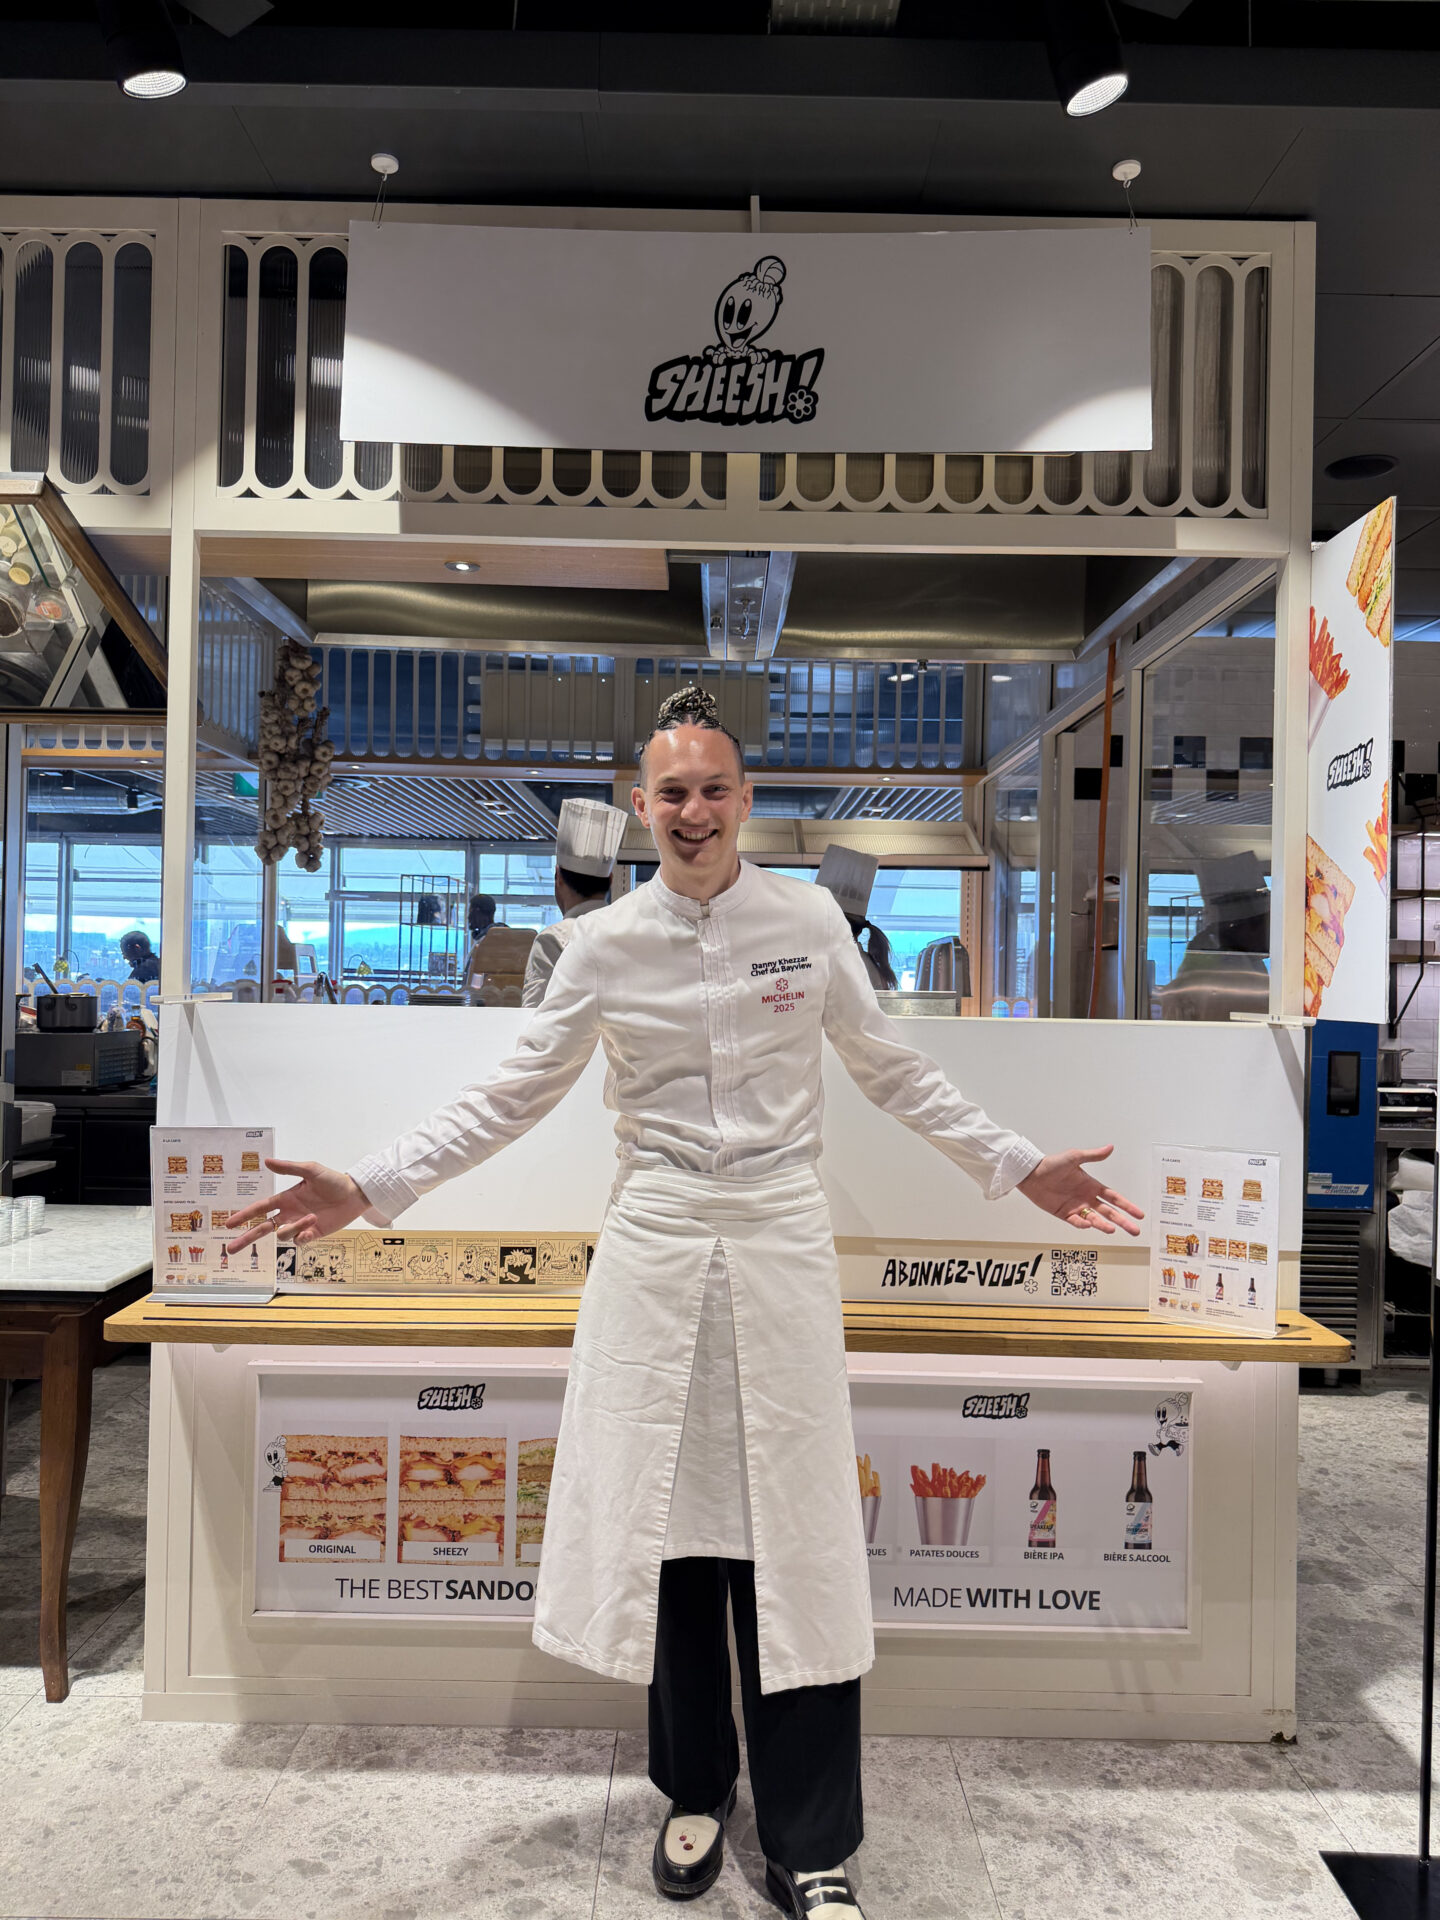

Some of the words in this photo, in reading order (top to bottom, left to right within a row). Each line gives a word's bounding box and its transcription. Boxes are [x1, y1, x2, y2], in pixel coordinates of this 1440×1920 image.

[645, 348, 825, 426] SHEESH!
[1327, 737, 1373, 791] SHEESH!
[751, 968, 768, 976] Chef
[770, 966, 780, 974] du
[781, 962, 812, 972] Bayview
[752, 961, 777, 970] Danny
[778, 957, 808, 965] Khezzar
[762, 991, 805, 1003] MICHELIN
[774, 1003, 795, 1013] 2025
[881, 1252, 1043, 1292] ABONNEZ-VOUS!
[418, 1383, 485, 1411] SHEESH!
[962, 1392, 1030, 1419] SHEESH!
[309, 1544, 356, 1555] ORIGINAL
[432, 1547, 469, 1556] SHEEZY
[910, 1549, 945, 1558] PATATES
[946, 1550, 980, 1559] DOUCES
[1024, 1550, 1048, 1560] BIÈRE
[1050, 1552, 1064, 1560] IPA
[1103, 1552, 1127, 1562] BIÈRE
[335, 1578, 380, 1599] THE
[387, 1579, 444, 1600] BEST
[445, 1580, 537, 1601] SANDO
[894, 1587, 962, 1608] MADE
[966, 1587, 1031, 1609] WITH
[1038, 1589, 1101, 1611] LOVE
